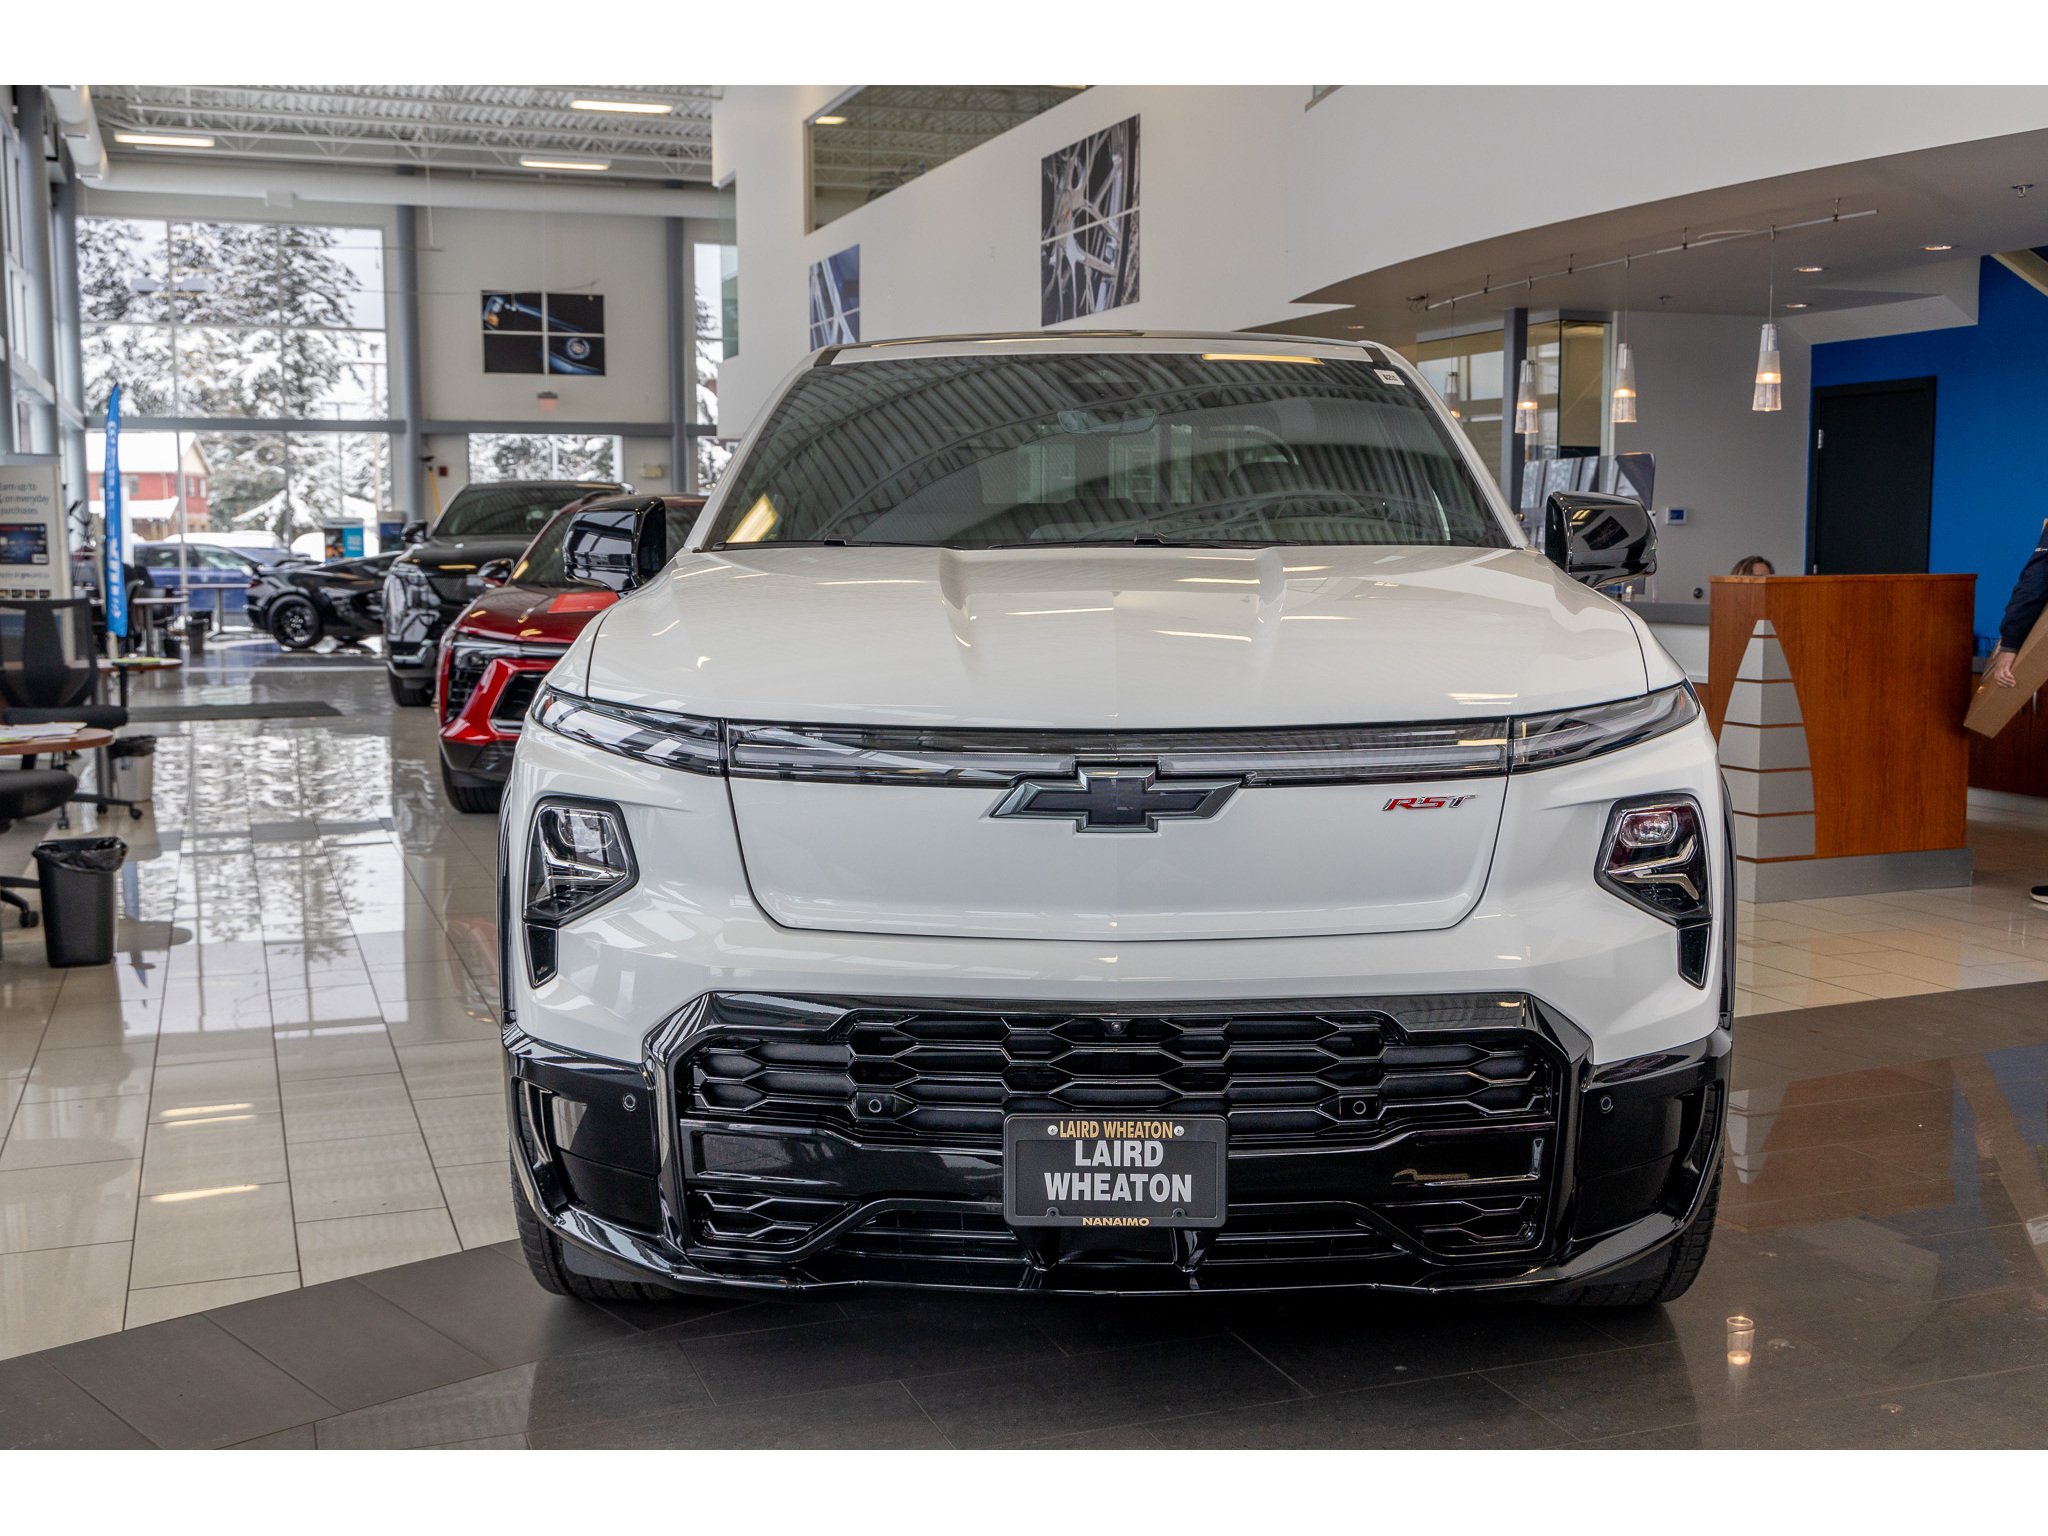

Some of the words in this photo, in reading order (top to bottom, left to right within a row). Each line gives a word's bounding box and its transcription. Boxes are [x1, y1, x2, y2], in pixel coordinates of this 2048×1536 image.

[17, 484, 27, 492] up
[28, 483, 38, 491] to
[1382, 793, 1478, 811] RST
[1059, 1120, 1099, 1138] LAIRD
[1103, 1121, 1173, 1139] WHEATON
[1075, 1139, 1164, 1167] LAIRD
[1044, 1172, 1192, 1203] WHEATON
[1082, 1217, 1150, 1227] NANAIMO
